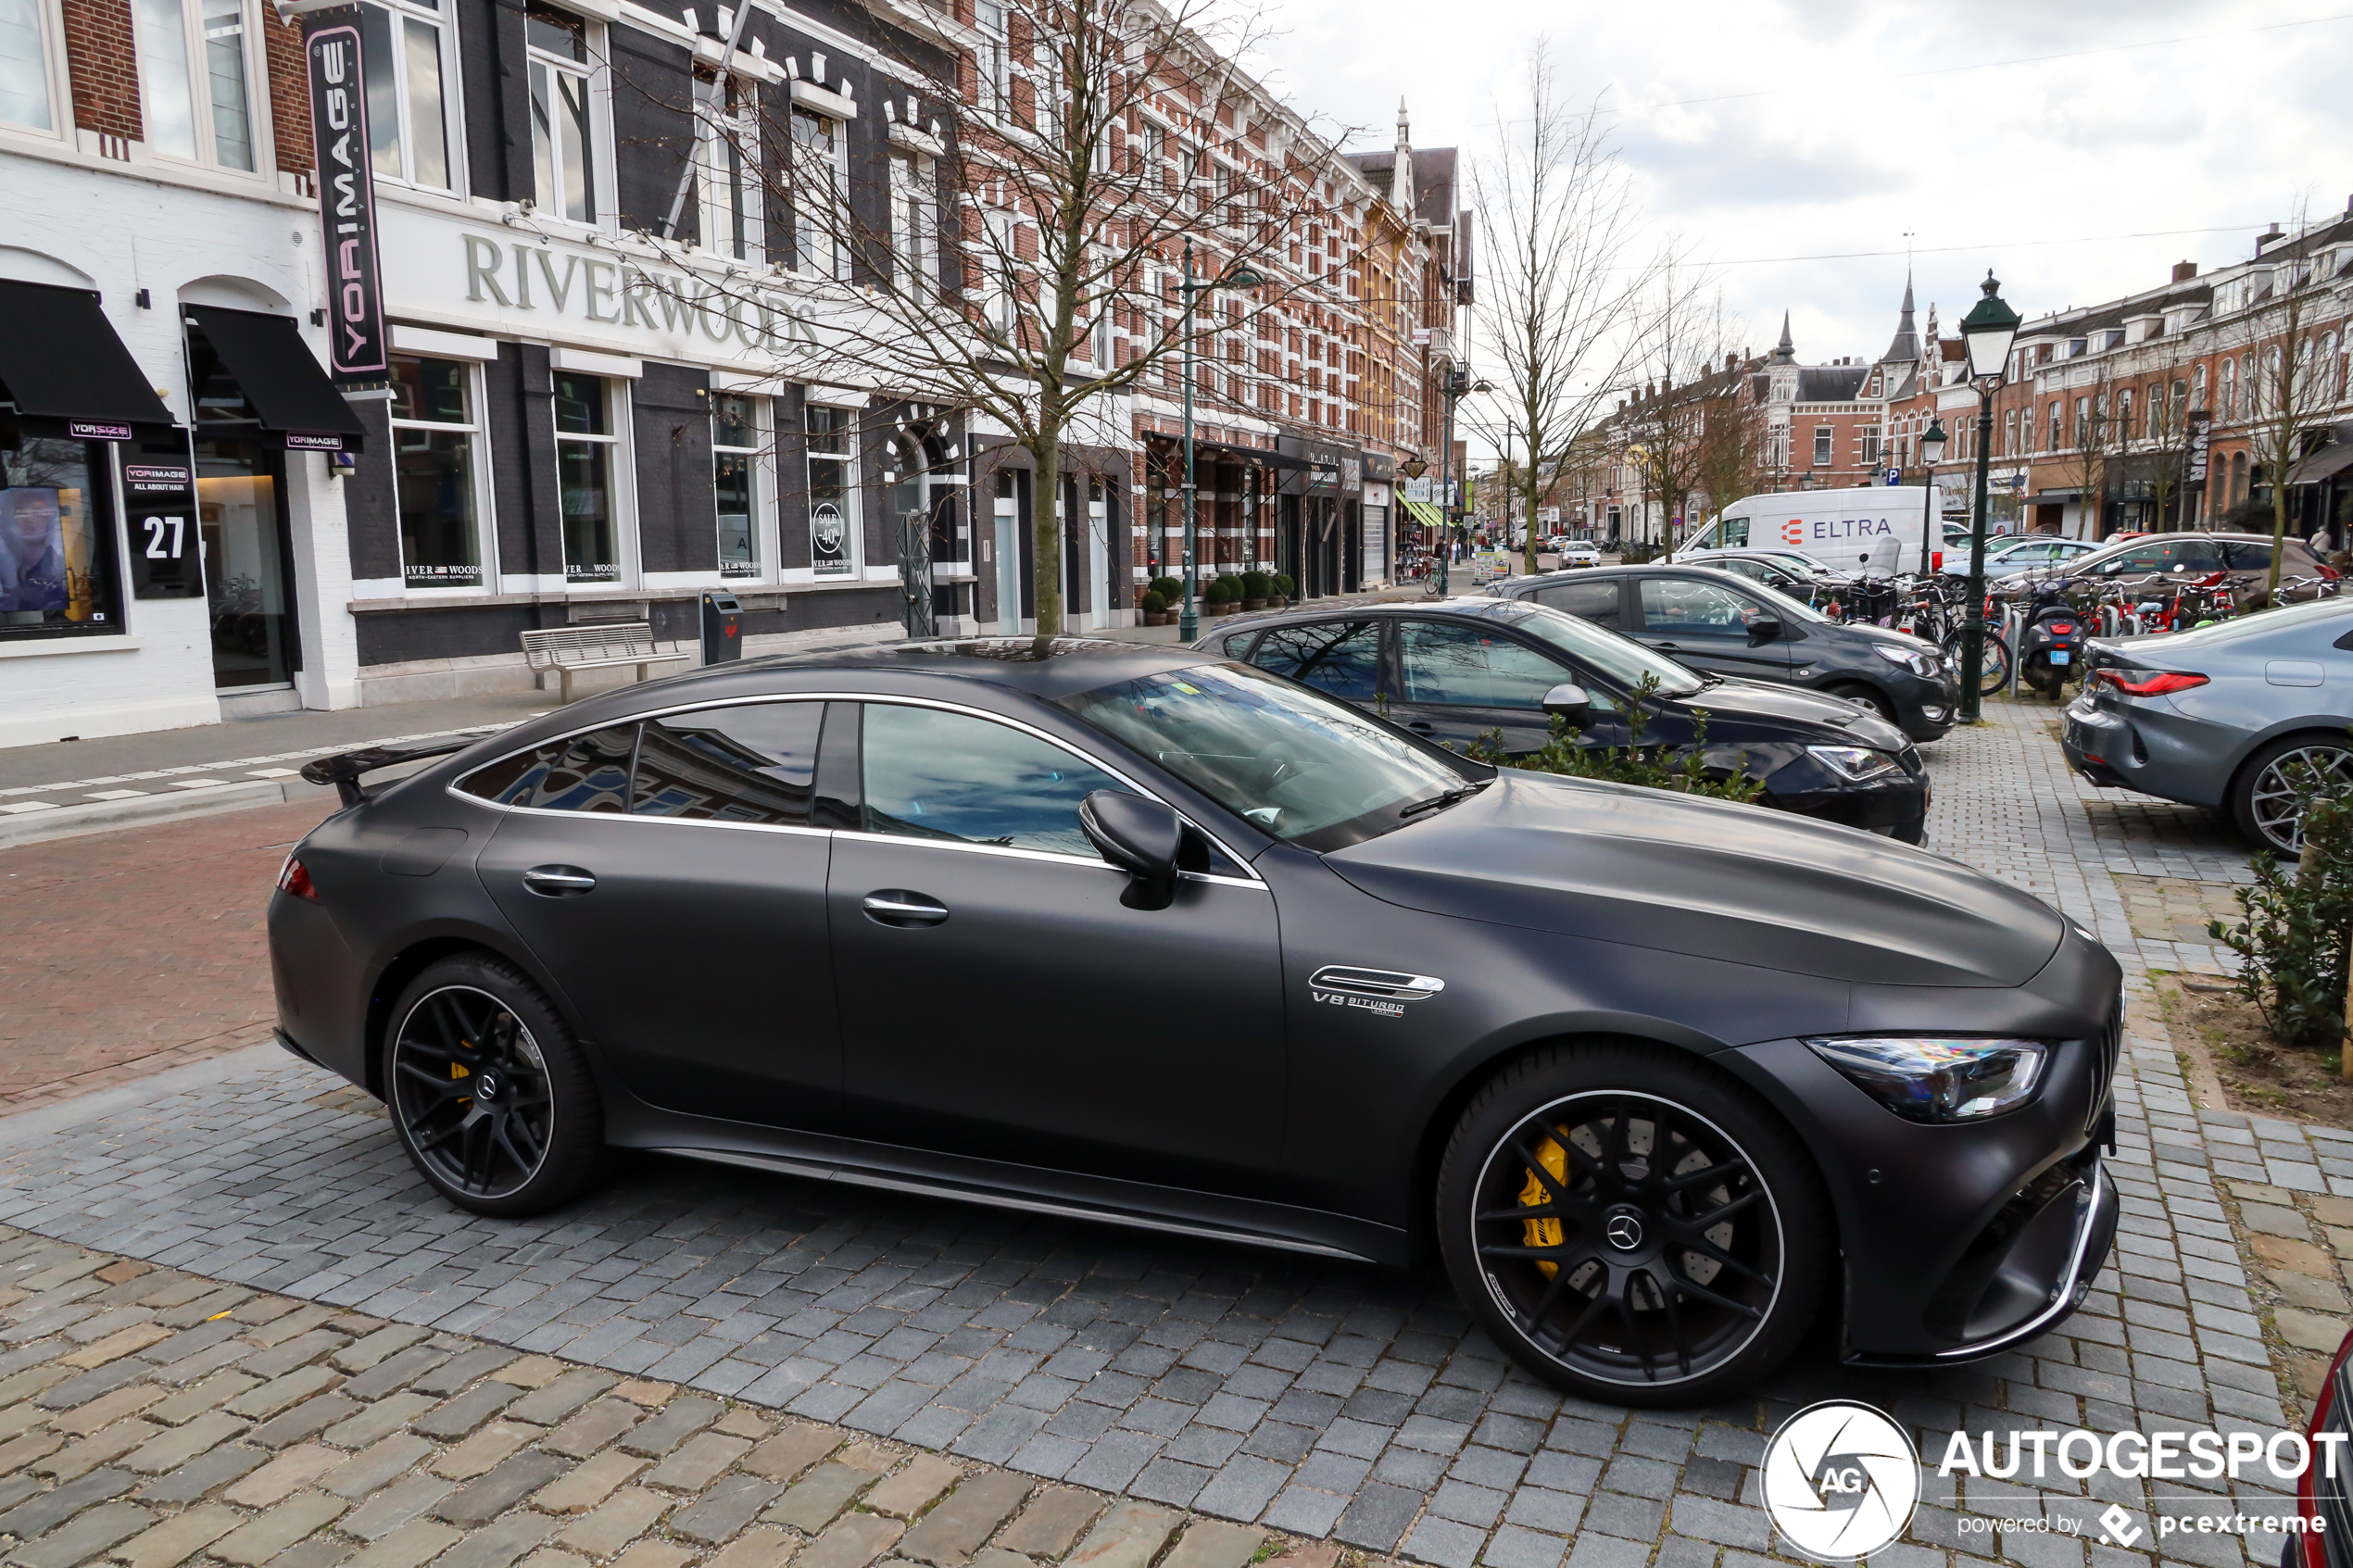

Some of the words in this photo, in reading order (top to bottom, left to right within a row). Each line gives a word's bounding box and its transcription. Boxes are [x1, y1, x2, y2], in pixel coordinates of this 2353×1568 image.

[322, 41, 368, 360] YORIMAGE
[459, 232, 820, 358] RIVERWOODS
[73, 423, 129, 435] YORSIZE
[289, 435, 340, 445] YORIMAGE
[129, 470, 187, 479] YORIMAGE
[1889, 470, 1898, 483] P
[134, 483, 147, 491] ALL
[818, 513, 837, 524] SALE
[1814, 518, 1892, 539] ELTRA
[144, 516, 184, 558] 27
[817, 528, 840, 545] -40%
[448, 565, 483, 574] WOODS
[1312, 991, 1345, 1006] V8
[1348, 997, 1405, 1011] BITURBO
